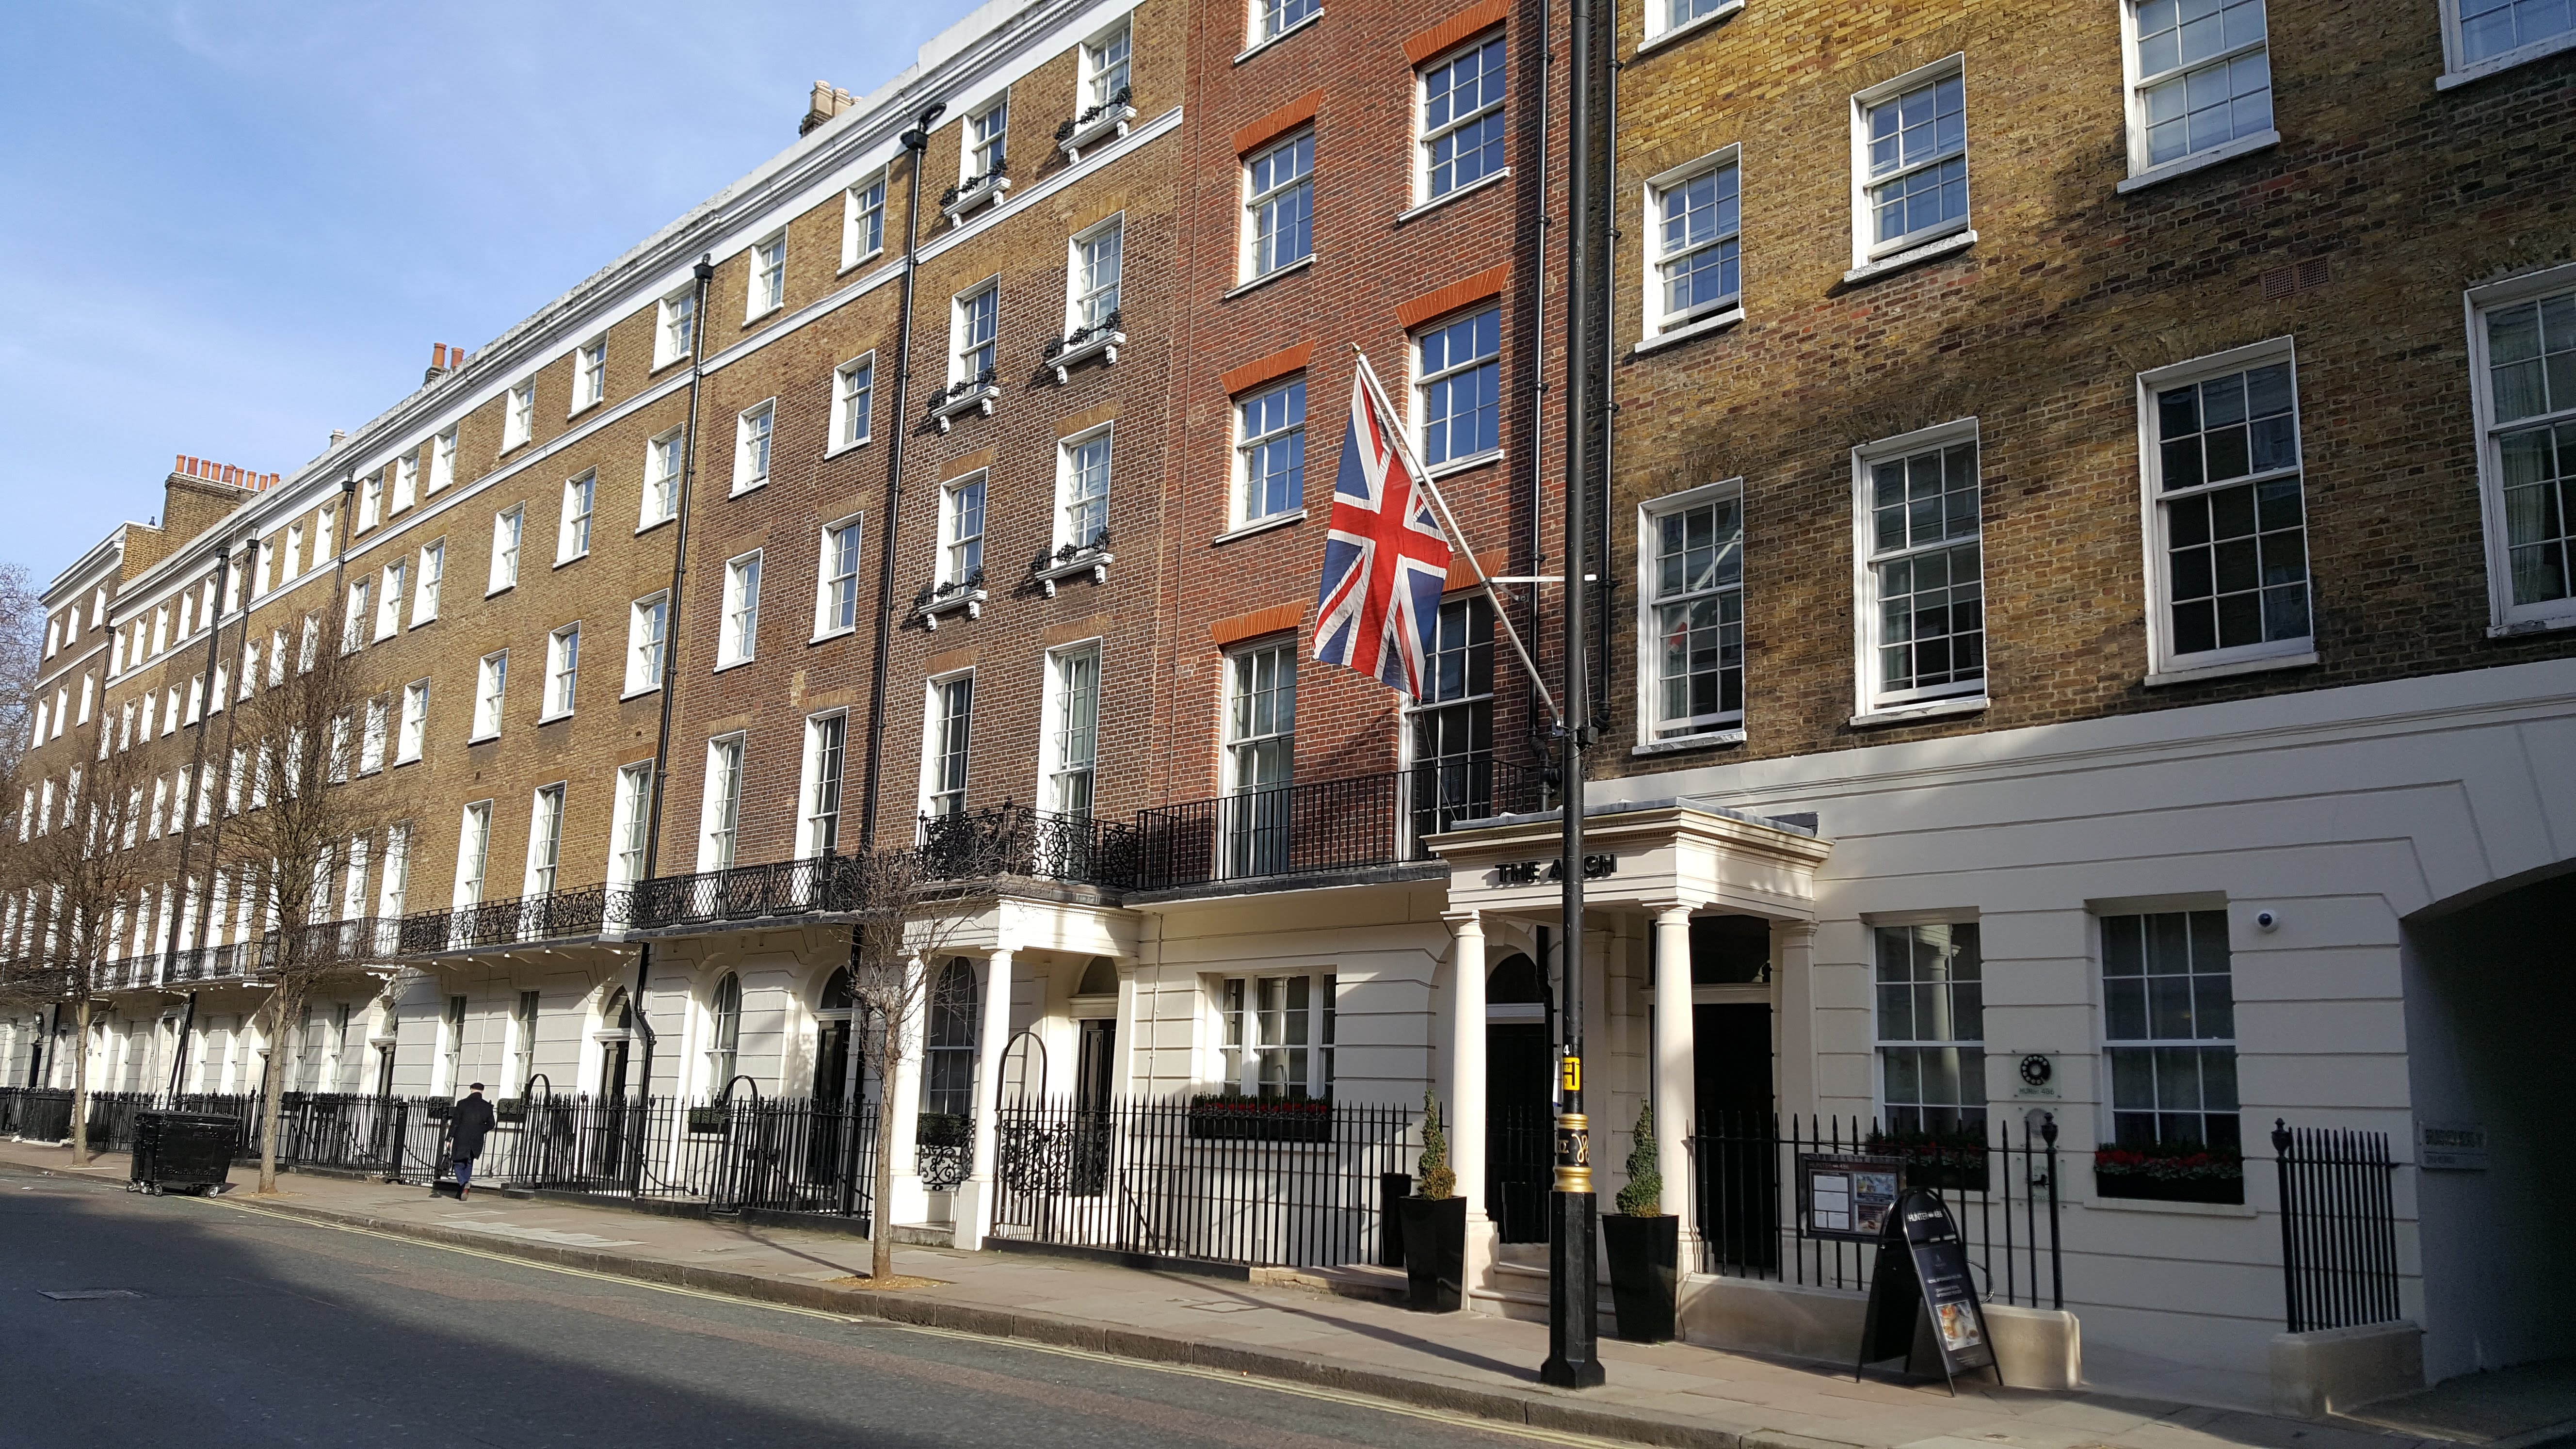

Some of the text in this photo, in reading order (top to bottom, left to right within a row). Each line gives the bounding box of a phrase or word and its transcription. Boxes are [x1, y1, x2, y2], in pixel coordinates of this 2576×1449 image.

[1495, 854, 1617, 883] THE ACH
[1908, 1212, 1929, 1222] HUNTER
